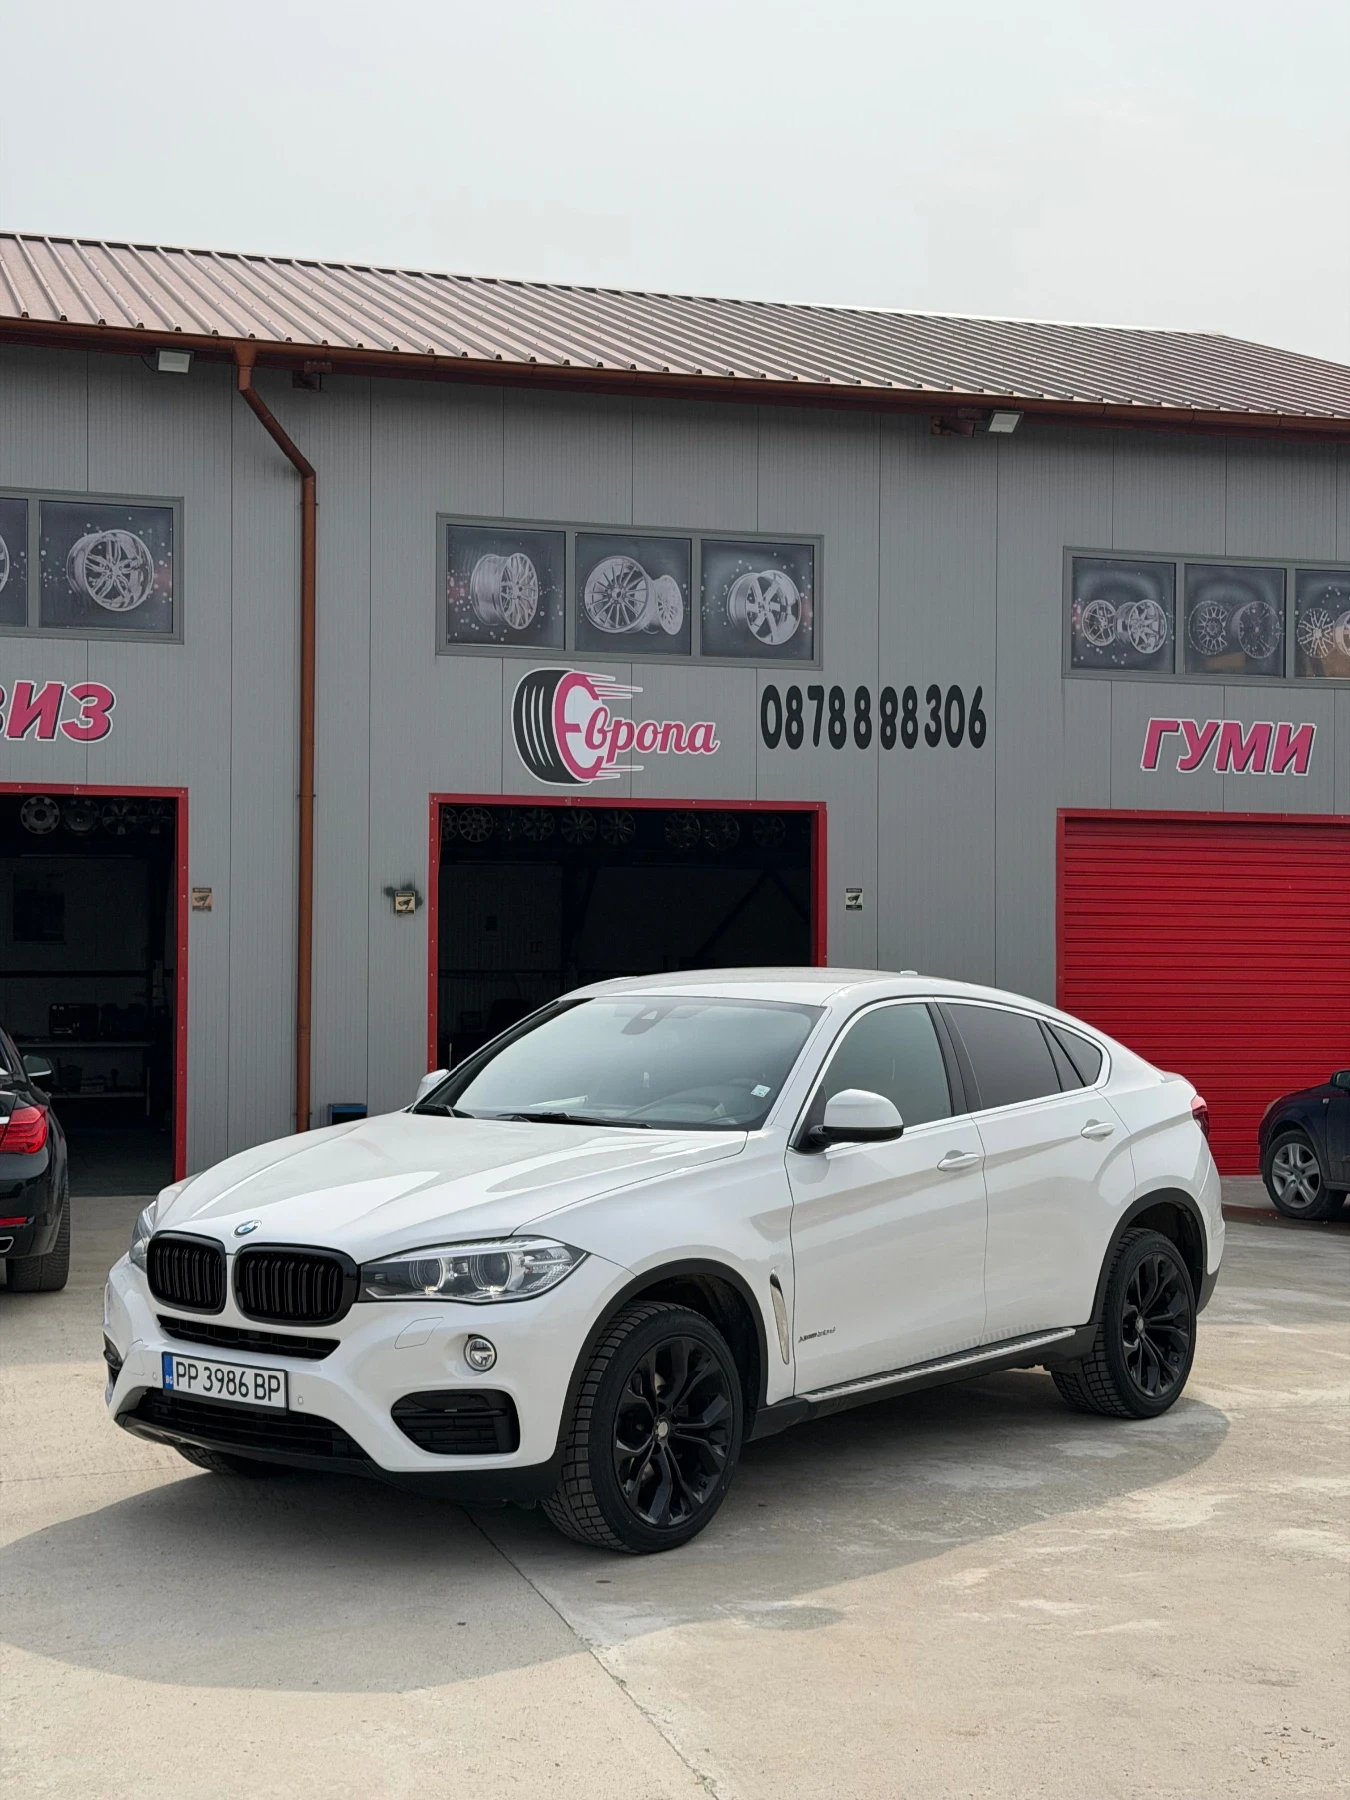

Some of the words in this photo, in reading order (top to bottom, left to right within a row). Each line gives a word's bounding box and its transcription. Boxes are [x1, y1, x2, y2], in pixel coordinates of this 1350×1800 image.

[0, 680, 116, 743] ИЗ
[553, 669, 720, 781] Европа
[760, 684, 987, 750] 0878888306
[1140, 717, 1317, 776] ГУМИ
[202, 1366, 250, 1398] 3986
